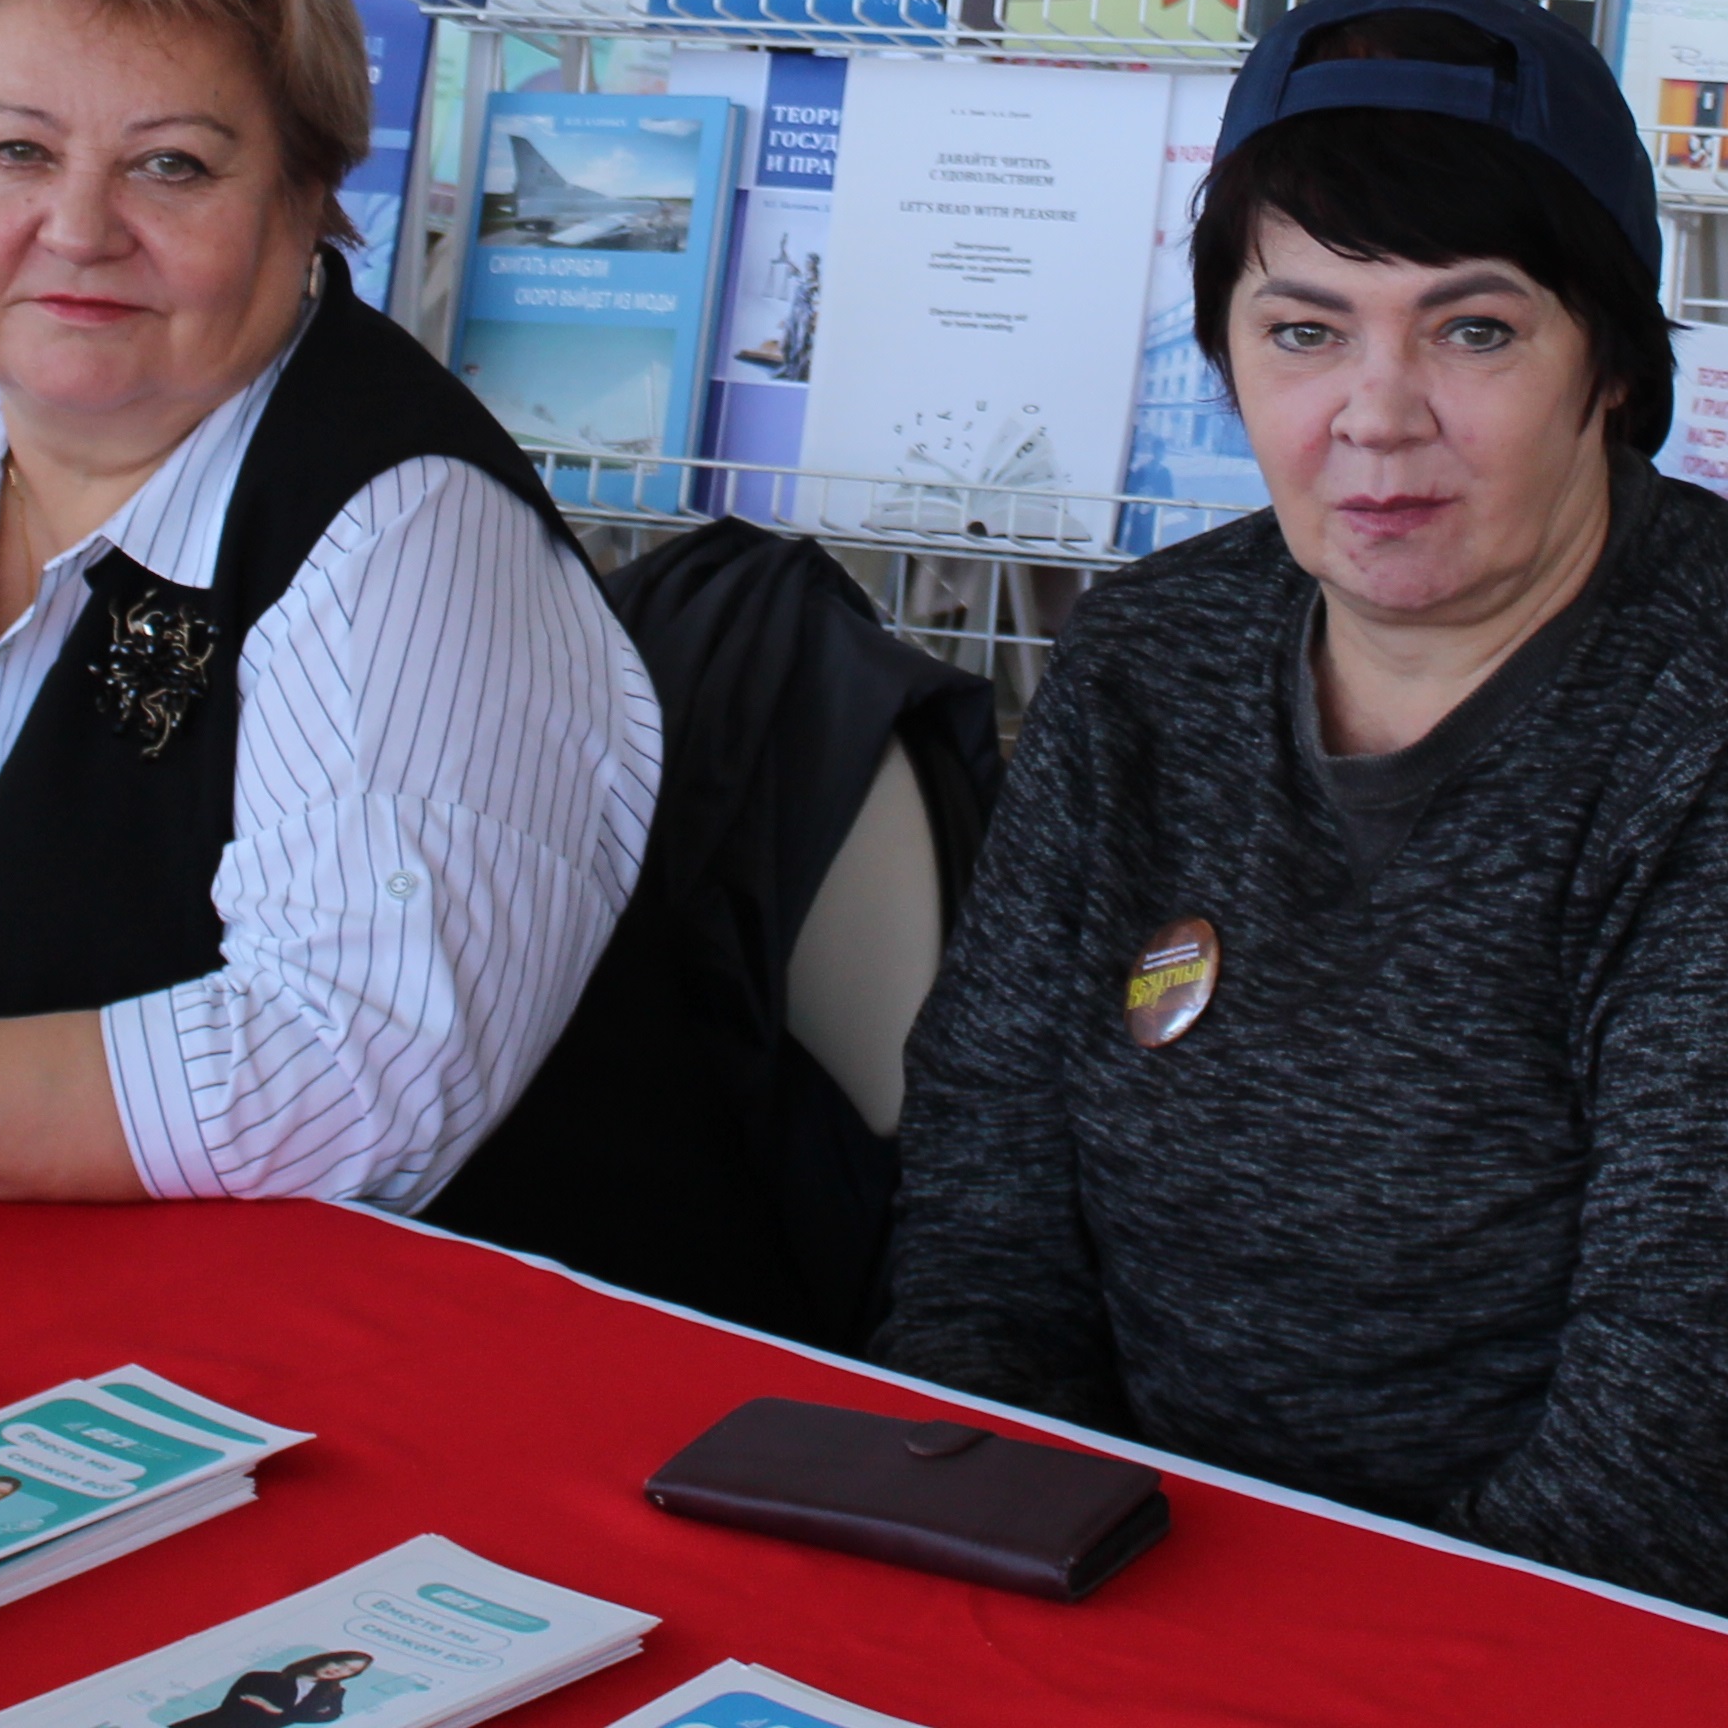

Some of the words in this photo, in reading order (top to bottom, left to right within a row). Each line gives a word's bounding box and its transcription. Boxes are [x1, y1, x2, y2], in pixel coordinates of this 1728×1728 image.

[937, 203, 970, 215] READ
[974, 205, 1010, 218] WITH
[1013, 207, 1077, 222] PLEASURE
